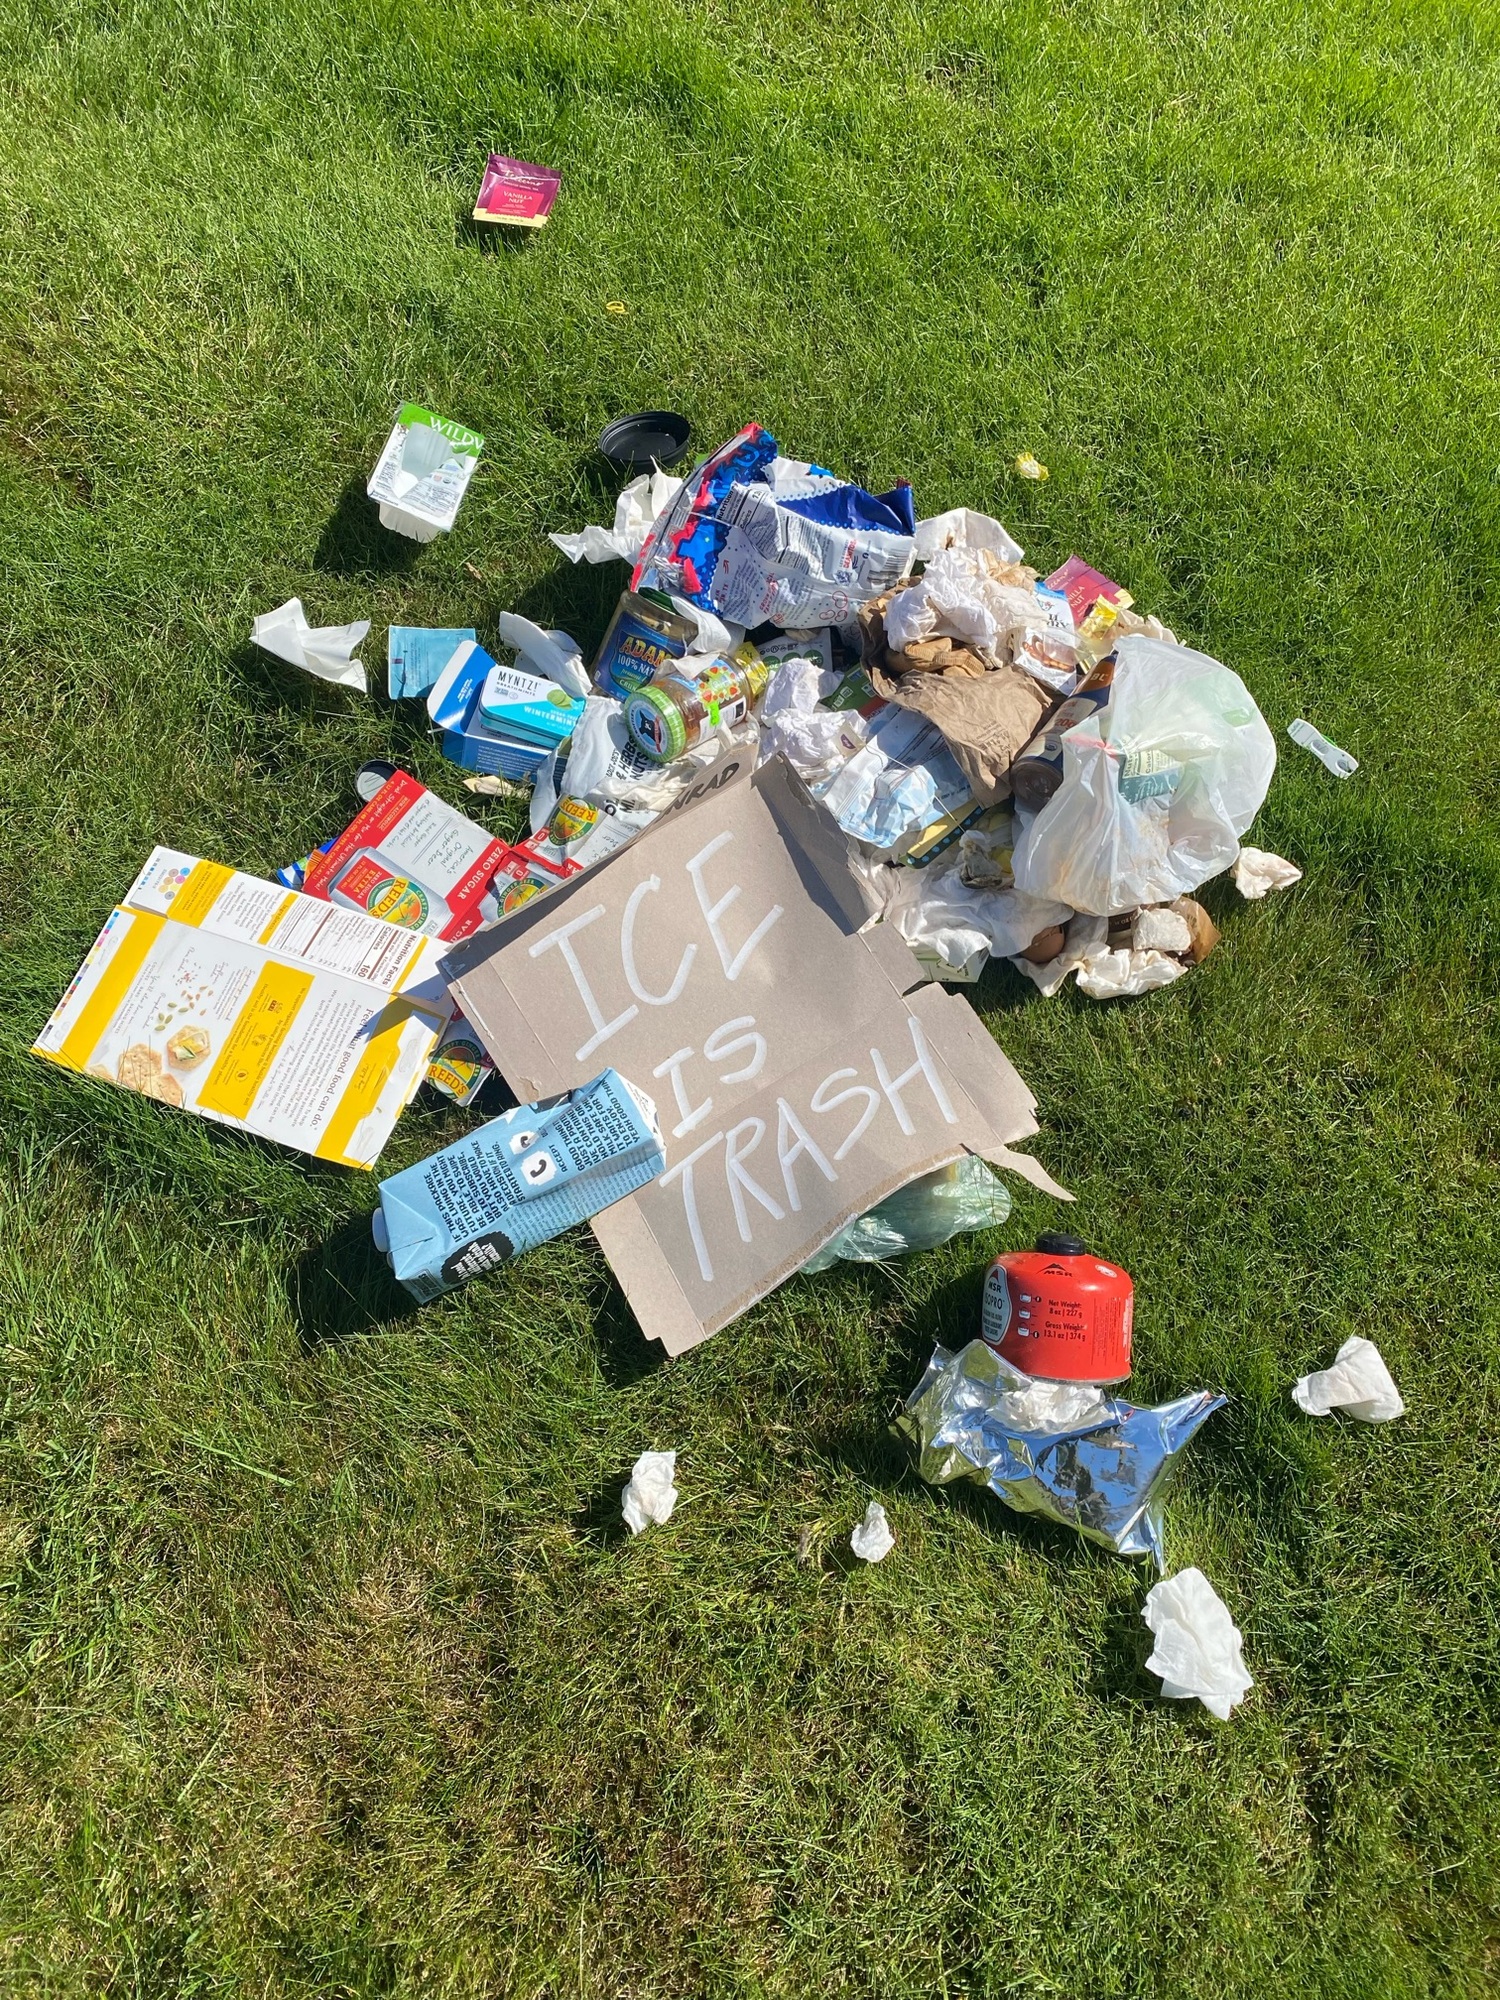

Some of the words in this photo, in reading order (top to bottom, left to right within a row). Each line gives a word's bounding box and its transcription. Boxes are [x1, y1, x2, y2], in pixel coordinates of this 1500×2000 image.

[496, 670, 538, 691] MYNTZ!
[371, 791, 396, 819] Straight
[425, 848, 442, 867] Beer
[446, 845, 474, 877] America's
[480, 845, 504, 871] ZERO
[352, 868, 375, 894] EXTRA
[456, 869, 484, 900] SUGAR
[370, 878, 408, 921] REED'S
[372, 925, 391, 951] Calories
[393, 933, 416, 966] Nutrition
[529, 829, 784, 1062] ICE
[356, 962, 371, 978] 160
[381, 964, 398, 986] Facts
[358, 1007, 374, 1028] Feel
[346, 1027, 364, 1052] what
[334, 1050, 353, 1074] good
[325, 1073, 342, 1095] food
[428, 1066, 468, 1097] REED'S
[653, 1014, 768, 1139] IS
[316, 1094, 330, 1112] can
[591, 1098, 606, 1115] FOR
[609, 1095, 627, 1120] GOOD
[581, 1115, 596, 1135] THIS
[588, 1111, 606, 1134] SAFE
[601, 1114, 621, 1141] WAITS
[605, 1105, 626, 1134] ENJOY.
[622, 1118, 641, 1142] YEAH
[554, 1123, 573, 1147] THING
[572, 1136, 581, 1144] A
[591, 1134, 609, 1159] HOLD
[600, 1132, 618, 1155] MILK
[615, 1140, 626, 1151] IT
[621, 1133, 633, 1146] TO
[469, 1139, 485, 1159] MAKE
[490, 1141, 506, 1161] RING.
[548, 1142, 568, 1173] ACCEPT
[566, 1145, 586, 1171] GOOD
[575, 1142, 594, 1167] JUST
[588, 1147, 601, 1163] IVE
[658, 1015, 959, 1283] TRASH
[428, 1161, 442, 1178] THE
[434, 1153, 453, 1178] MIGHT
[445, 1154, 463, 1177] SWIPE
[453, 1150, 485, 1197] SUBSCRIBE,
[465, 1155, 484, 1181] WOULD
[478, 1157, 488, 1168] TO
[434, 1177, 445, 1188] IN
[445, 1177, 460, 1196] YOU
[455, 1176, 467, 1189] TO
[478, 1180, 493, 1200] YOU
[481, 1167, 498, 1190] HAVE
[503, 1166, 526, 1202] STARTED
[421, 1171, 448, 1211] PACKAGE
[439, 1186, 459, 1216] LIVING
[462, 1189, 479, 1214] ABLE
[493, 1189, 510, 1212] ALSO
[454, 1194, 480, 1233] FUTURE,
[476, 1196, 488, 1210] TO
[488, 1200, 503, 1218] BUT
[441, 1210, 457, 1233] THIS
[454, 1216, 470, 1238] WAS
[474, 1213, 487, 1228] BE
[483, 1208, 495, 1223] UP
[452, 1232, 462, 1242] IF
[1043, 1269, 1074, 1278] MSR
[987, 1280, 1002, 1293] MSR
[1048, 1299, 1059, 1308] Net
[1060, 1300, 1082, 1310] Weight:
[1066, 1308, 1078, 1317] 227
[1043, 1330, 1057, 1339] 13.1
[1069, 1331, 1081, 1340] 374
[1045, 1321, 1062, 1330] Gross
